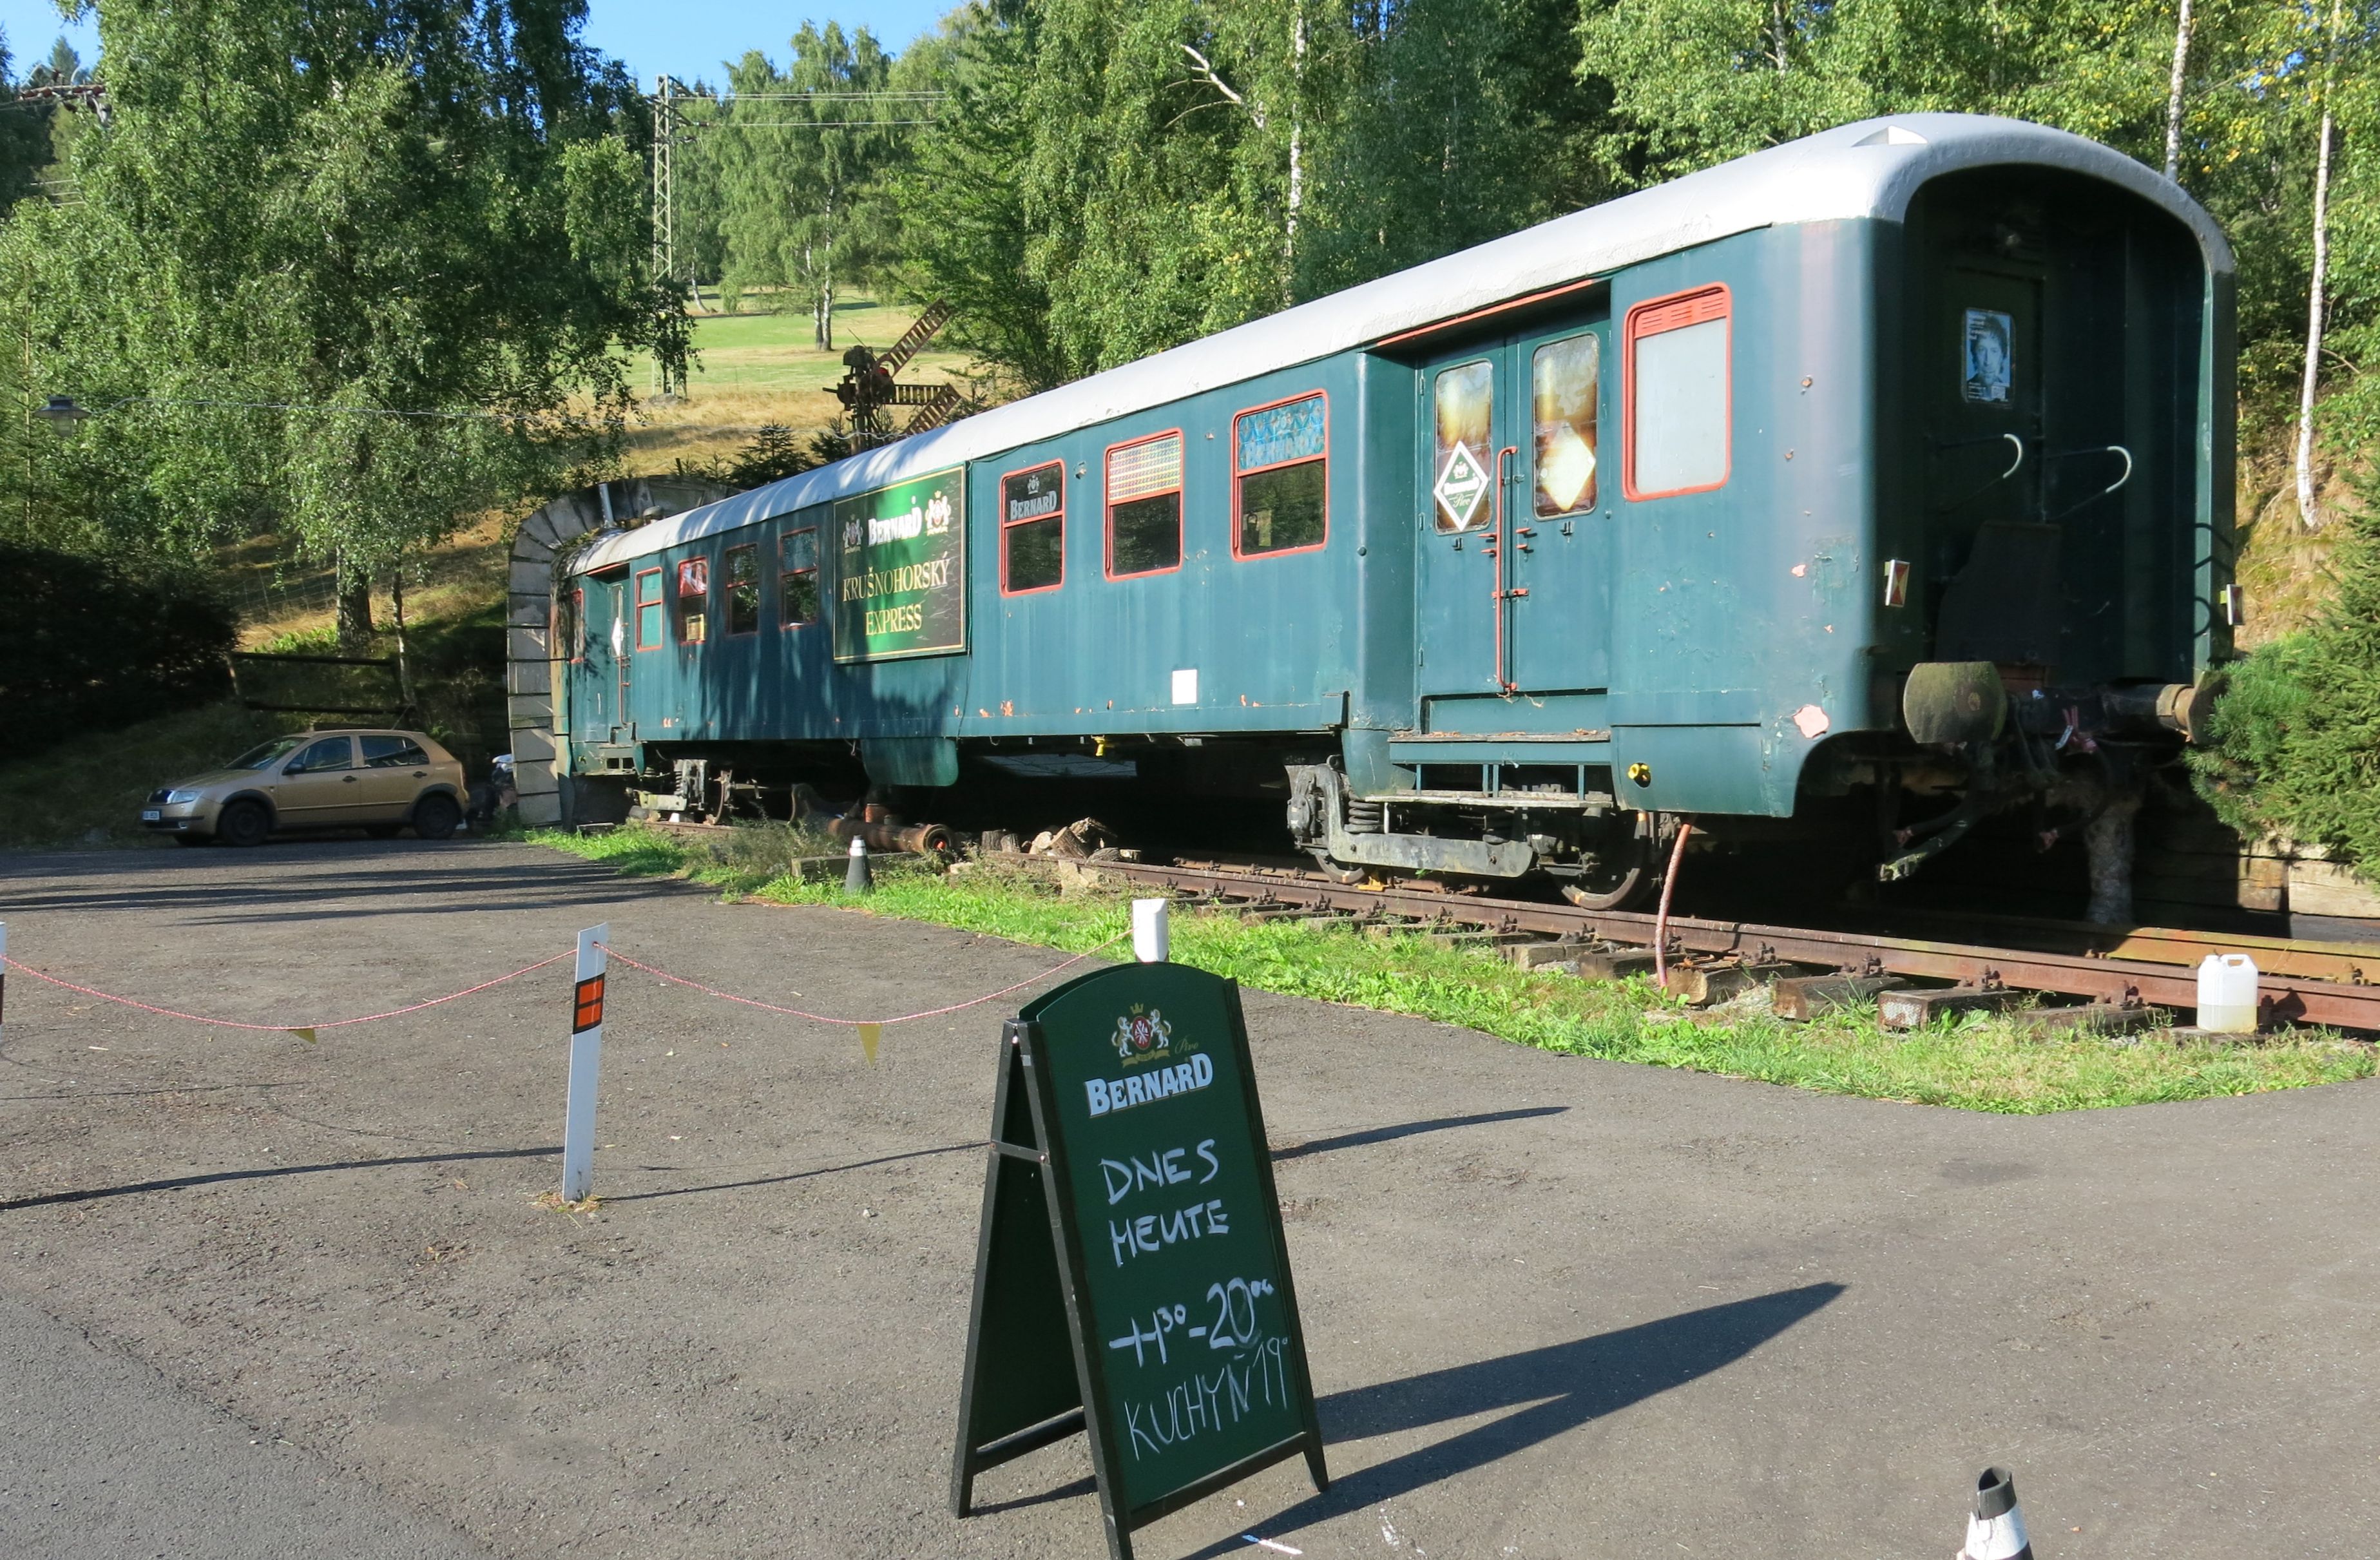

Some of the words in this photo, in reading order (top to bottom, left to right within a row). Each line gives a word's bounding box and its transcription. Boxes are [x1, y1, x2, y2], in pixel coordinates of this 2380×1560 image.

[868, 506, 922, 546] BERNARD
[1010, 490, 1057, 521] BERNARD
[843, 551, 951, 602] KRUŠNOHORSKÝ
[865, 604, 922, 636] EXPRESS
[1175, 1034, 1199, 1054] Pivo
[1084, 1052, 1213, 1119] BERNARD
[1098, 1139, 1220, 1205] DNES
[1108, 1199, 1230, 1268] HEUTE
